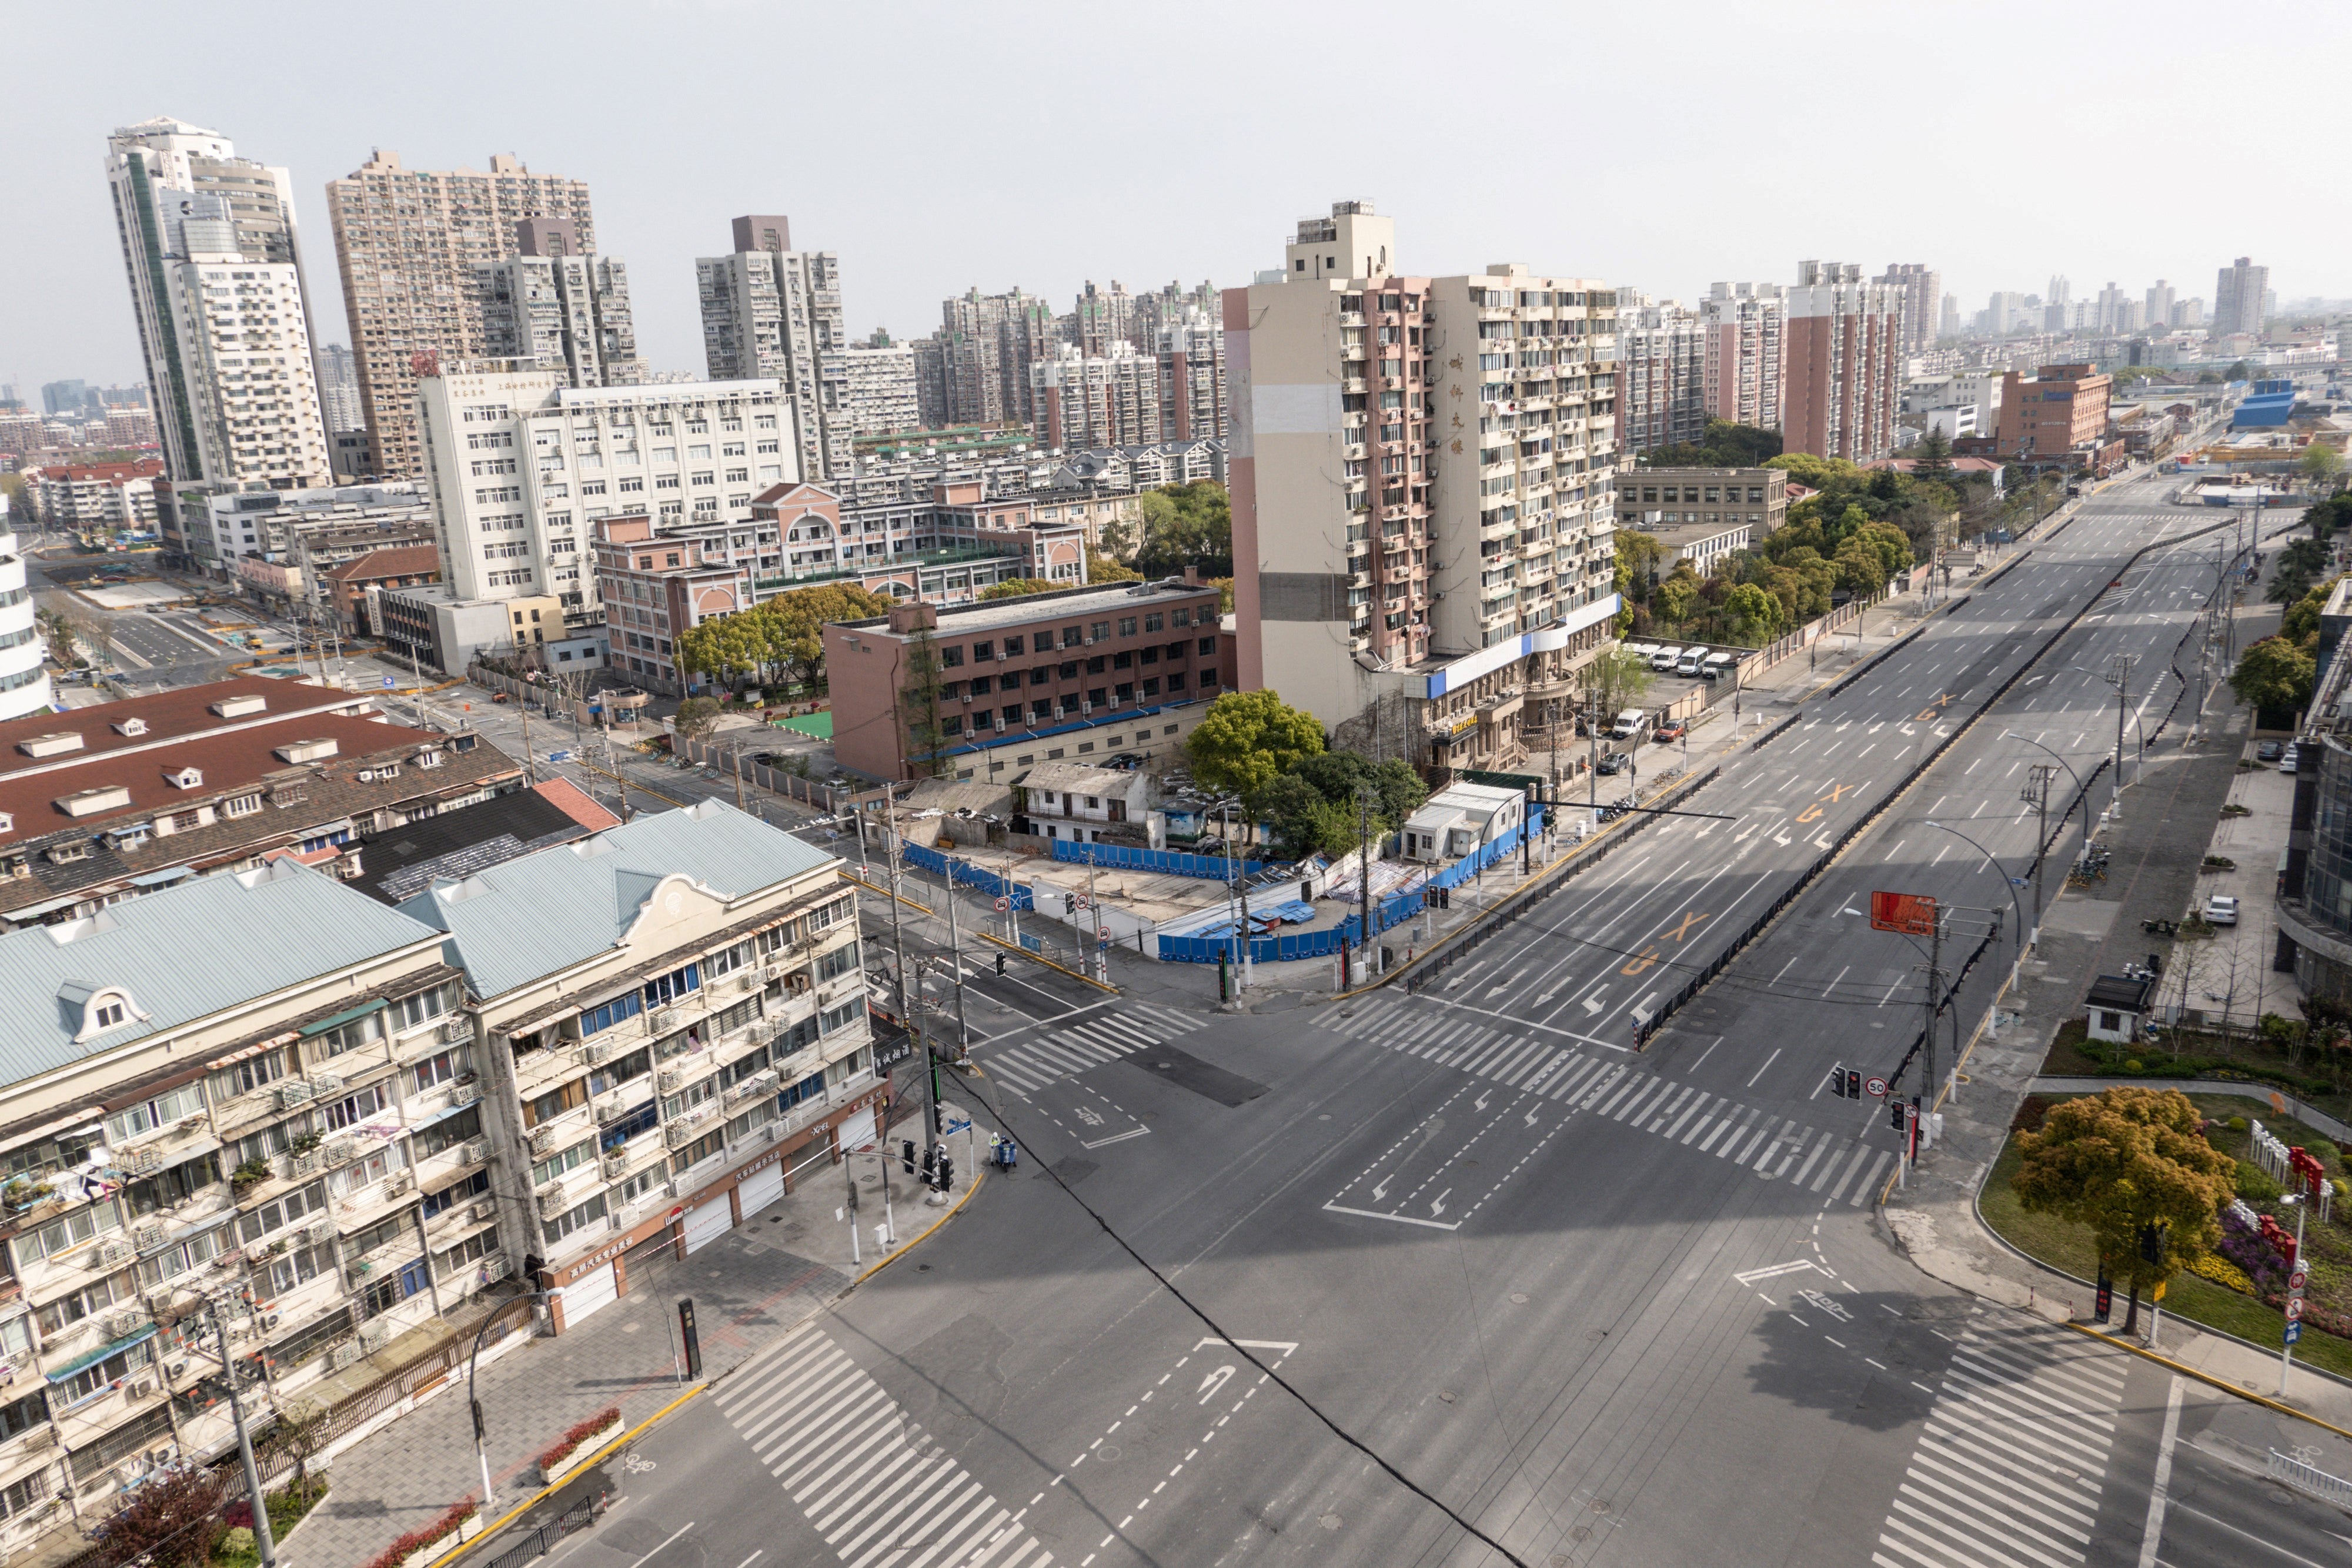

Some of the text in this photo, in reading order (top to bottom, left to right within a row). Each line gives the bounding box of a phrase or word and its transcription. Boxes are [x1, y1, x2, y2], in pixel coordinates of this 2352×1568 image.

[1870, 1083, 1884, 1092] 50
[813, 1122, 830, 1136] XPEL
[735, 1151, 780, 1182] 汽车贴膜示范店
[570, 1236, 633, 1279] 高朋汽车专业美容
